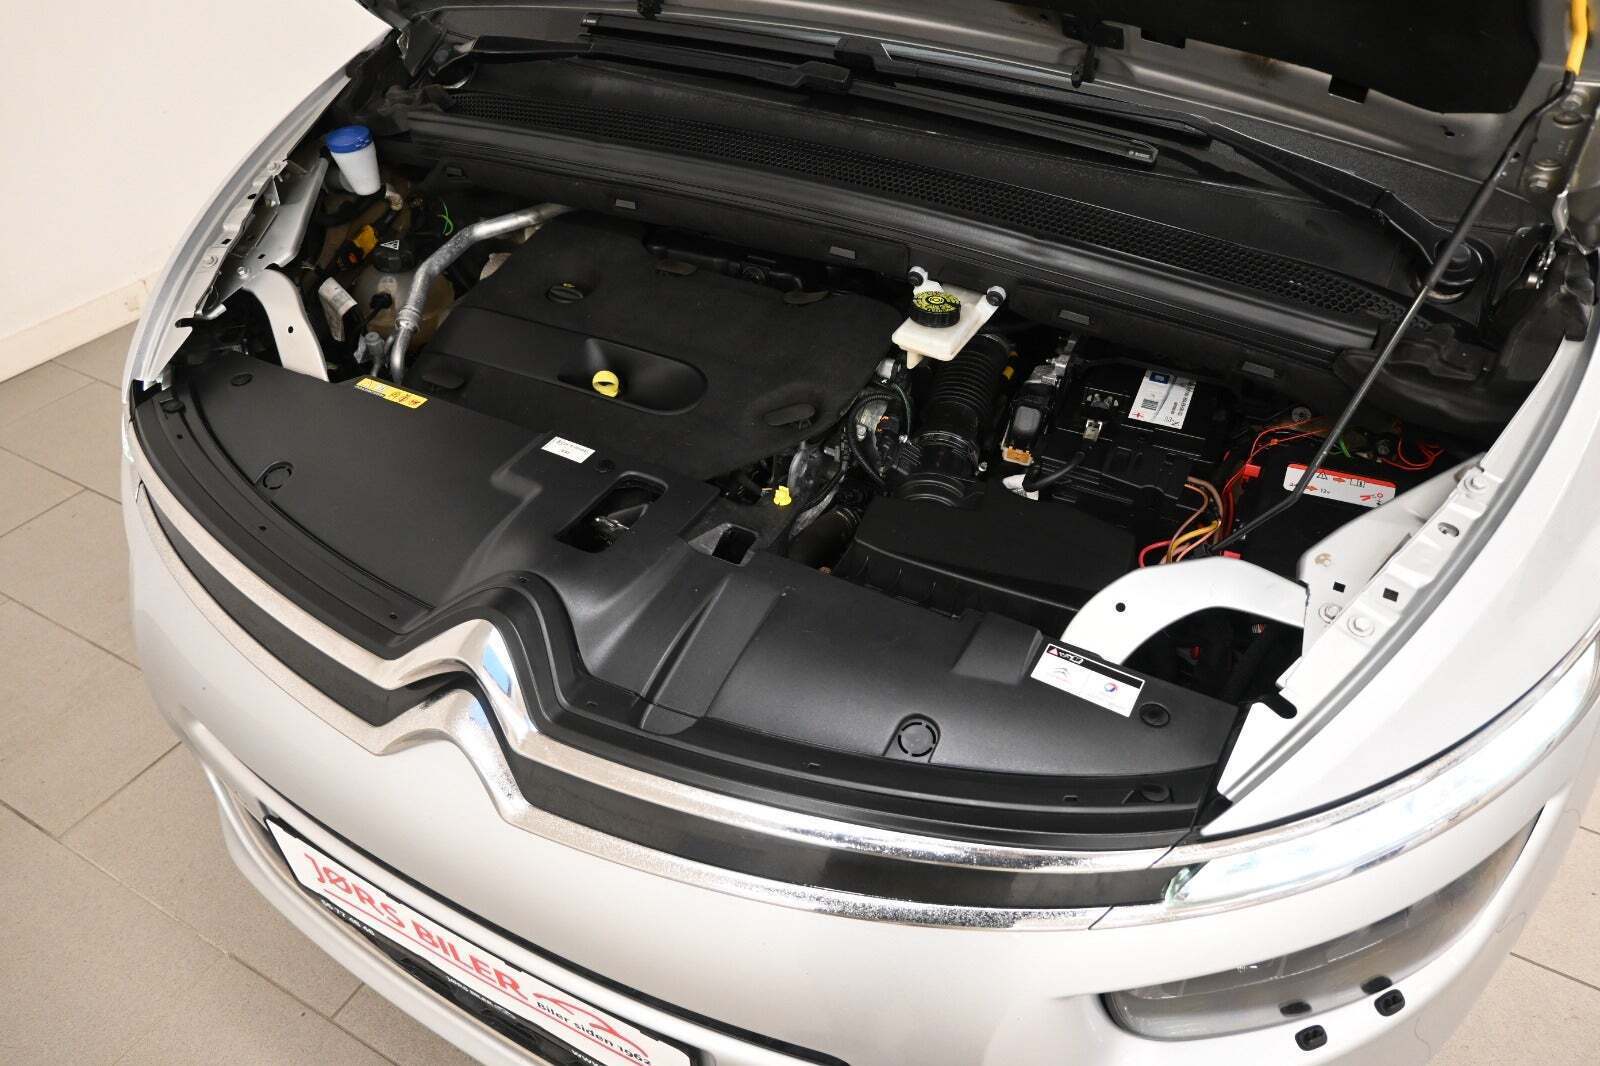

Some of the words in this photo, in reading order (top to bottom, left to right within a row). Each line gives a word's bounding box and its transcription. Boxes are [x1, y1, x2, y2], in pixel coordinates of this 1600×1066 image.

[304, 853, 405, 928] JØRS
[412, 919, 529, 1000] BILER
[536, 1001, 569, 1023] Biler
[574, 1022, 614, 1047] siden
